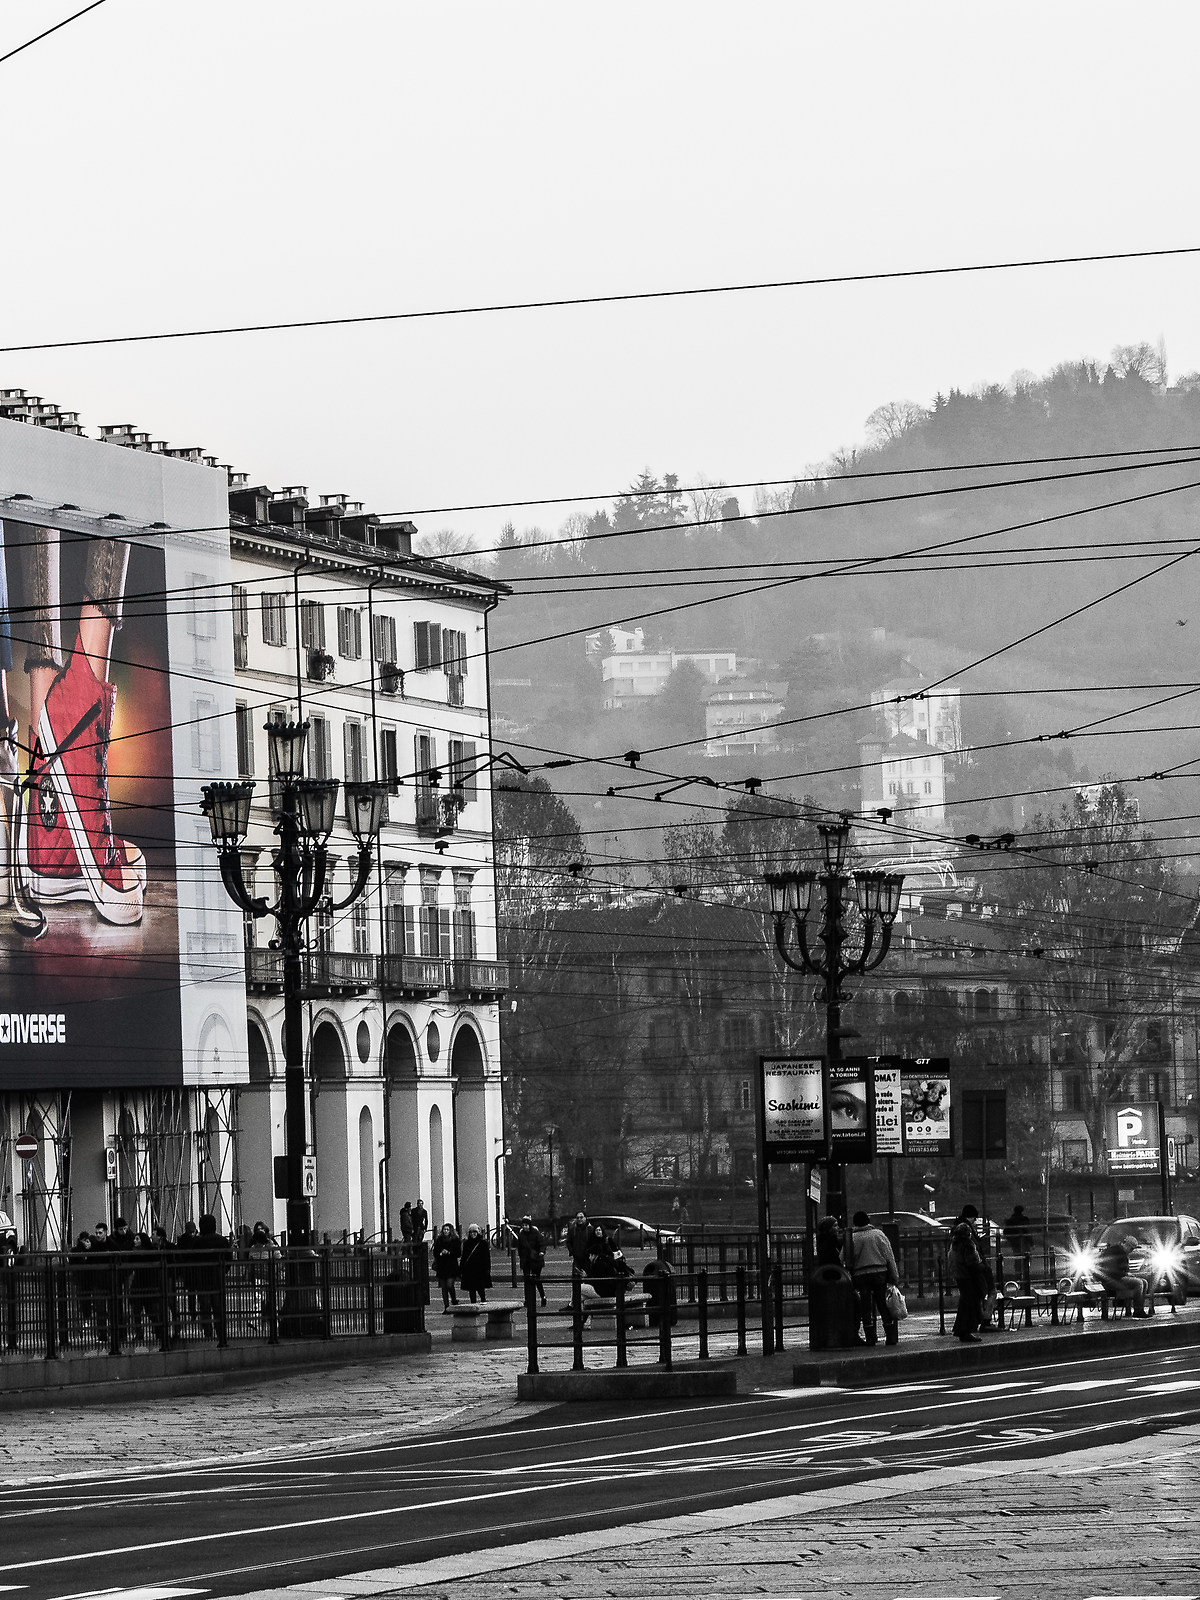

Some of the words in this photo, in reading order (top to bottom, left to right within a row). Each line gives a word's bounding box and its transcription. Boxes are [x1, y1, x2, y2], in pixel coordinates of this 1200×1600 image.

[765, 1069, 821, 1077] RESTAURANT
[875, 1072, 897, 1082] OMA?
[768, 1095, 821, 1112] Sashimi
[877, 1115, 898, 1126] ilei
[1117, 1116, 1143, 1148] P
